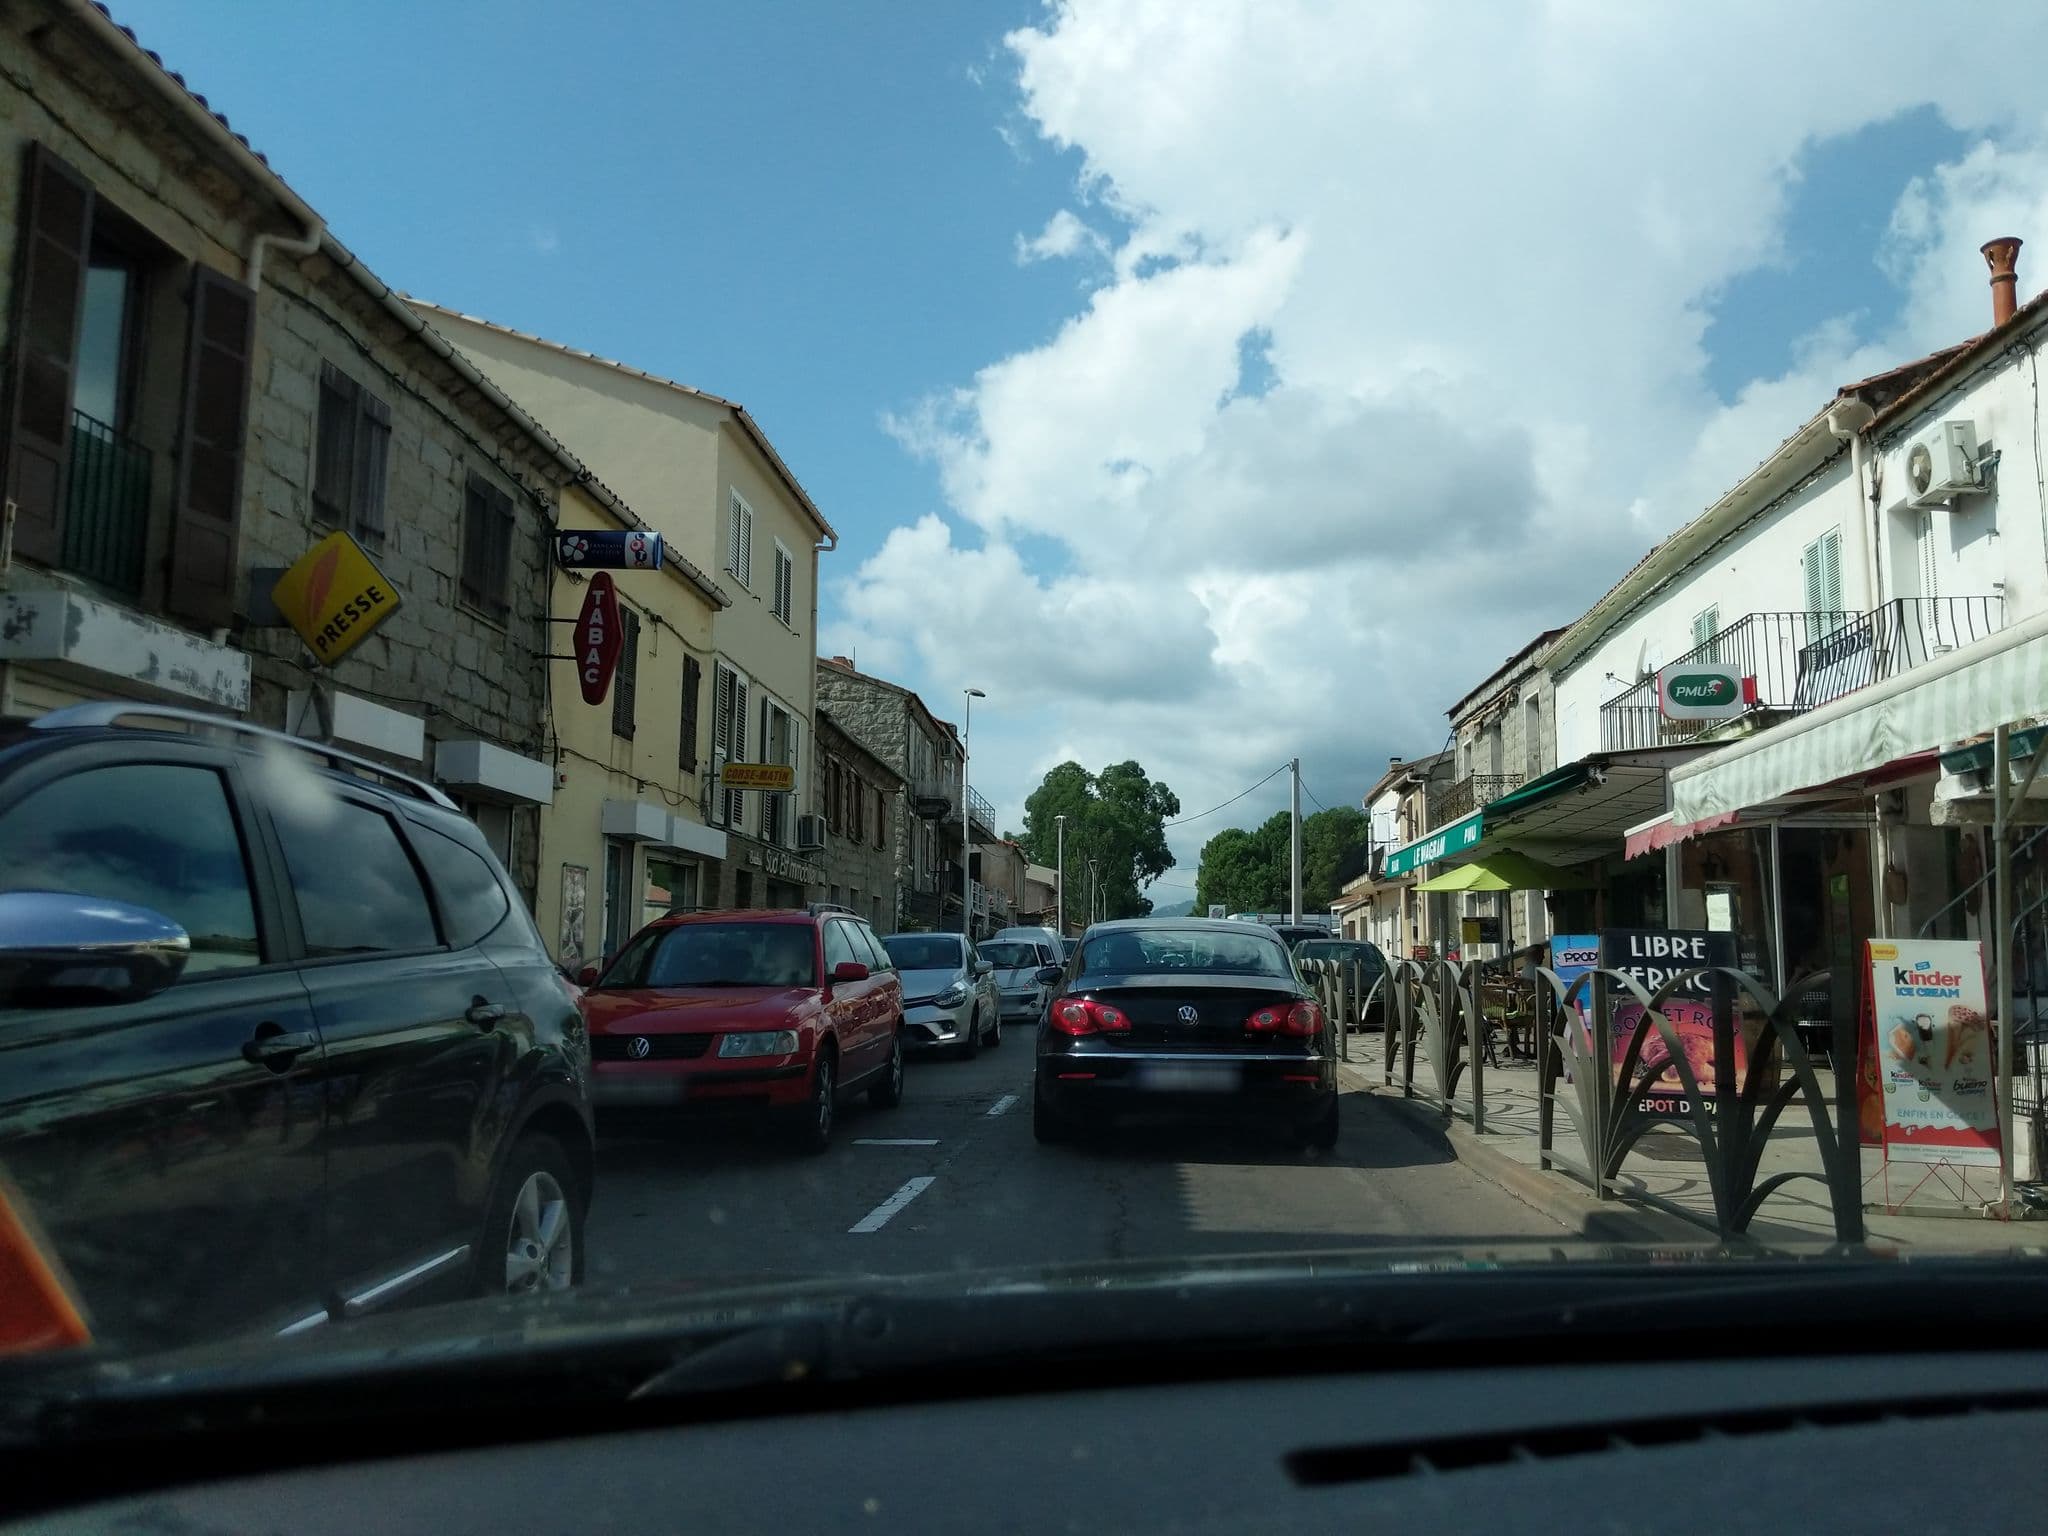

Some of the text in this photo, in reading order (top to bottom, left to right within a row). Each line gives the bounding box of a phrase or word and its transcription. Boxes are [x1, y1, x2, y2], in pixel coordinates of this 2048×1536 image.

[315, 585, 385, 654] PRESSE
[585, 590, 605, 684] TABAC
[1675, 685, 1707, 698] PMU
[1630, 935, 1706, 960] LIBRE
[1616, 965, 1713, 993] SERVIC
